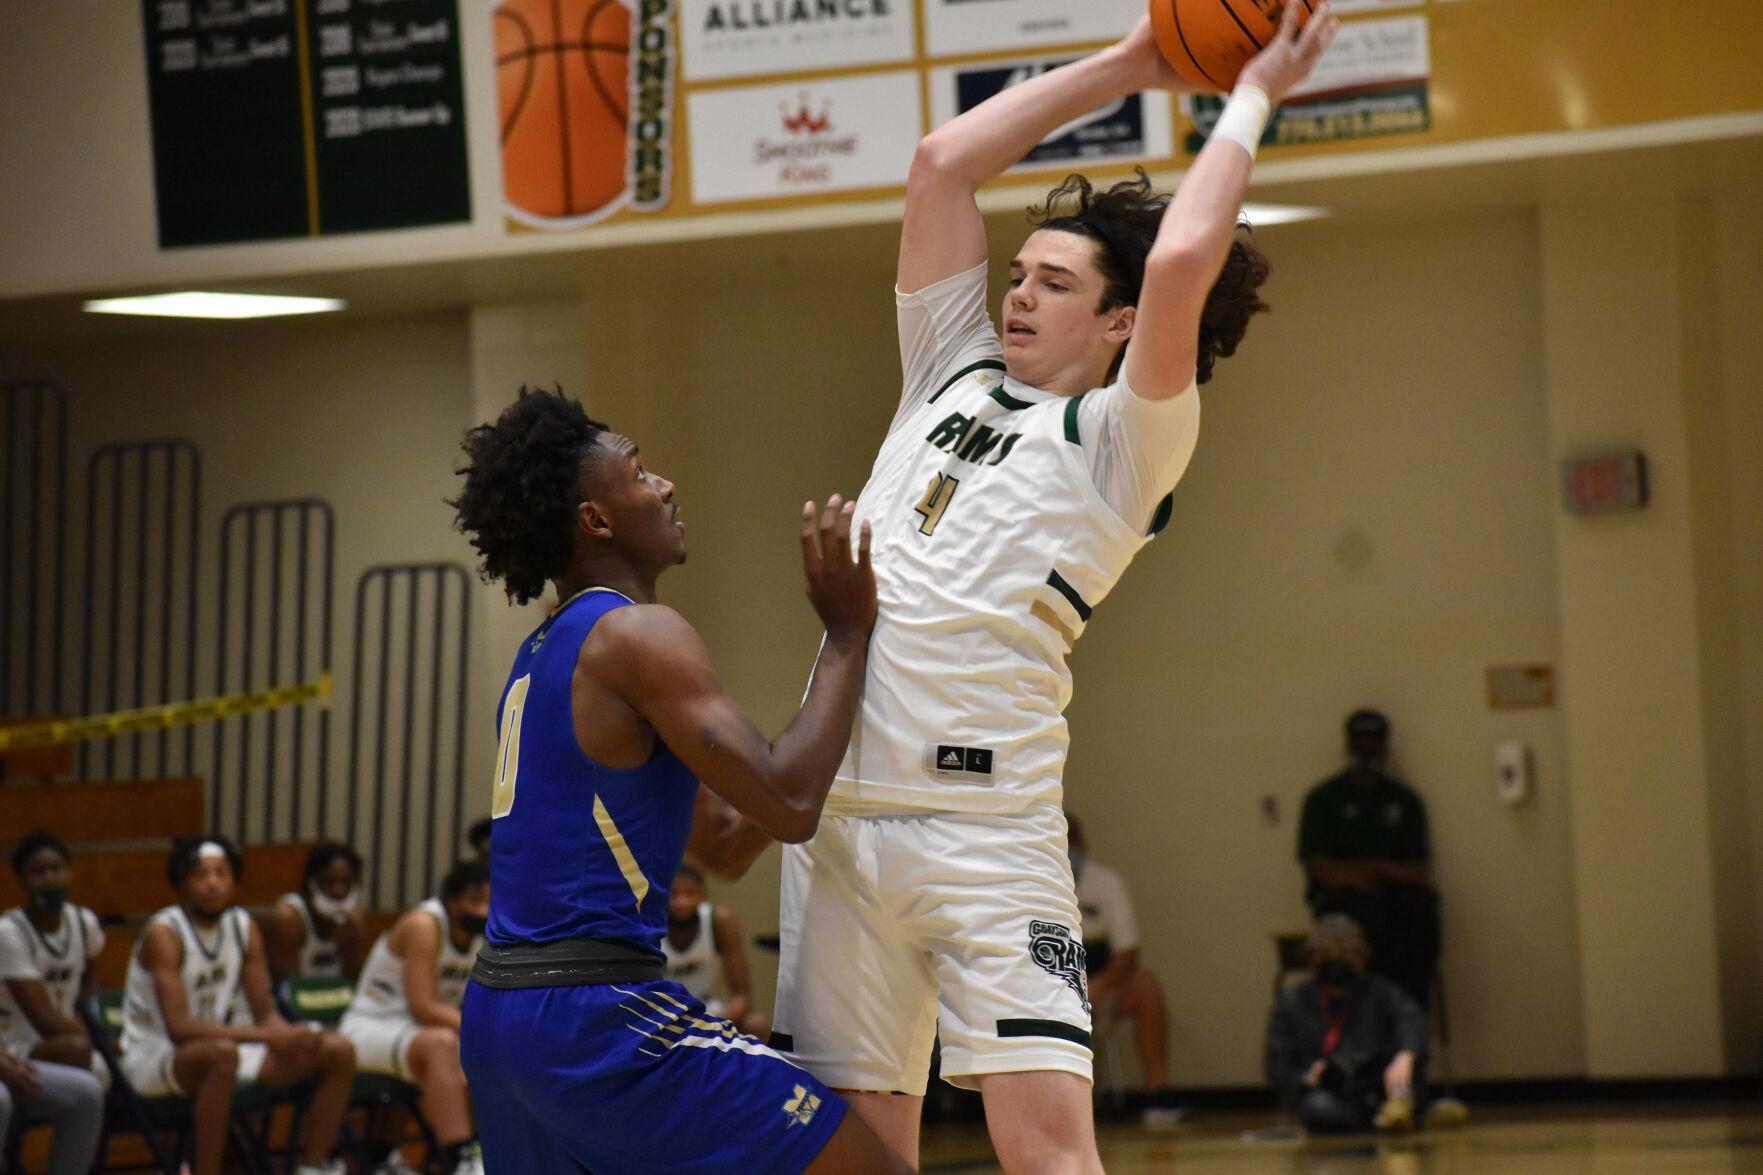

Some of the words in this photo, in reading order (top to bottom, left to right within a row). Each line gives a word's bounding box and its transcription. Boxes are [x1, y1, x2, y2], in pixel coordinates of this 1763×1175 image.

[704, 0, 890, 31] ALLIANCE
[914, 470, 960, 537] 4
[491, 672, 531, 820] 0
